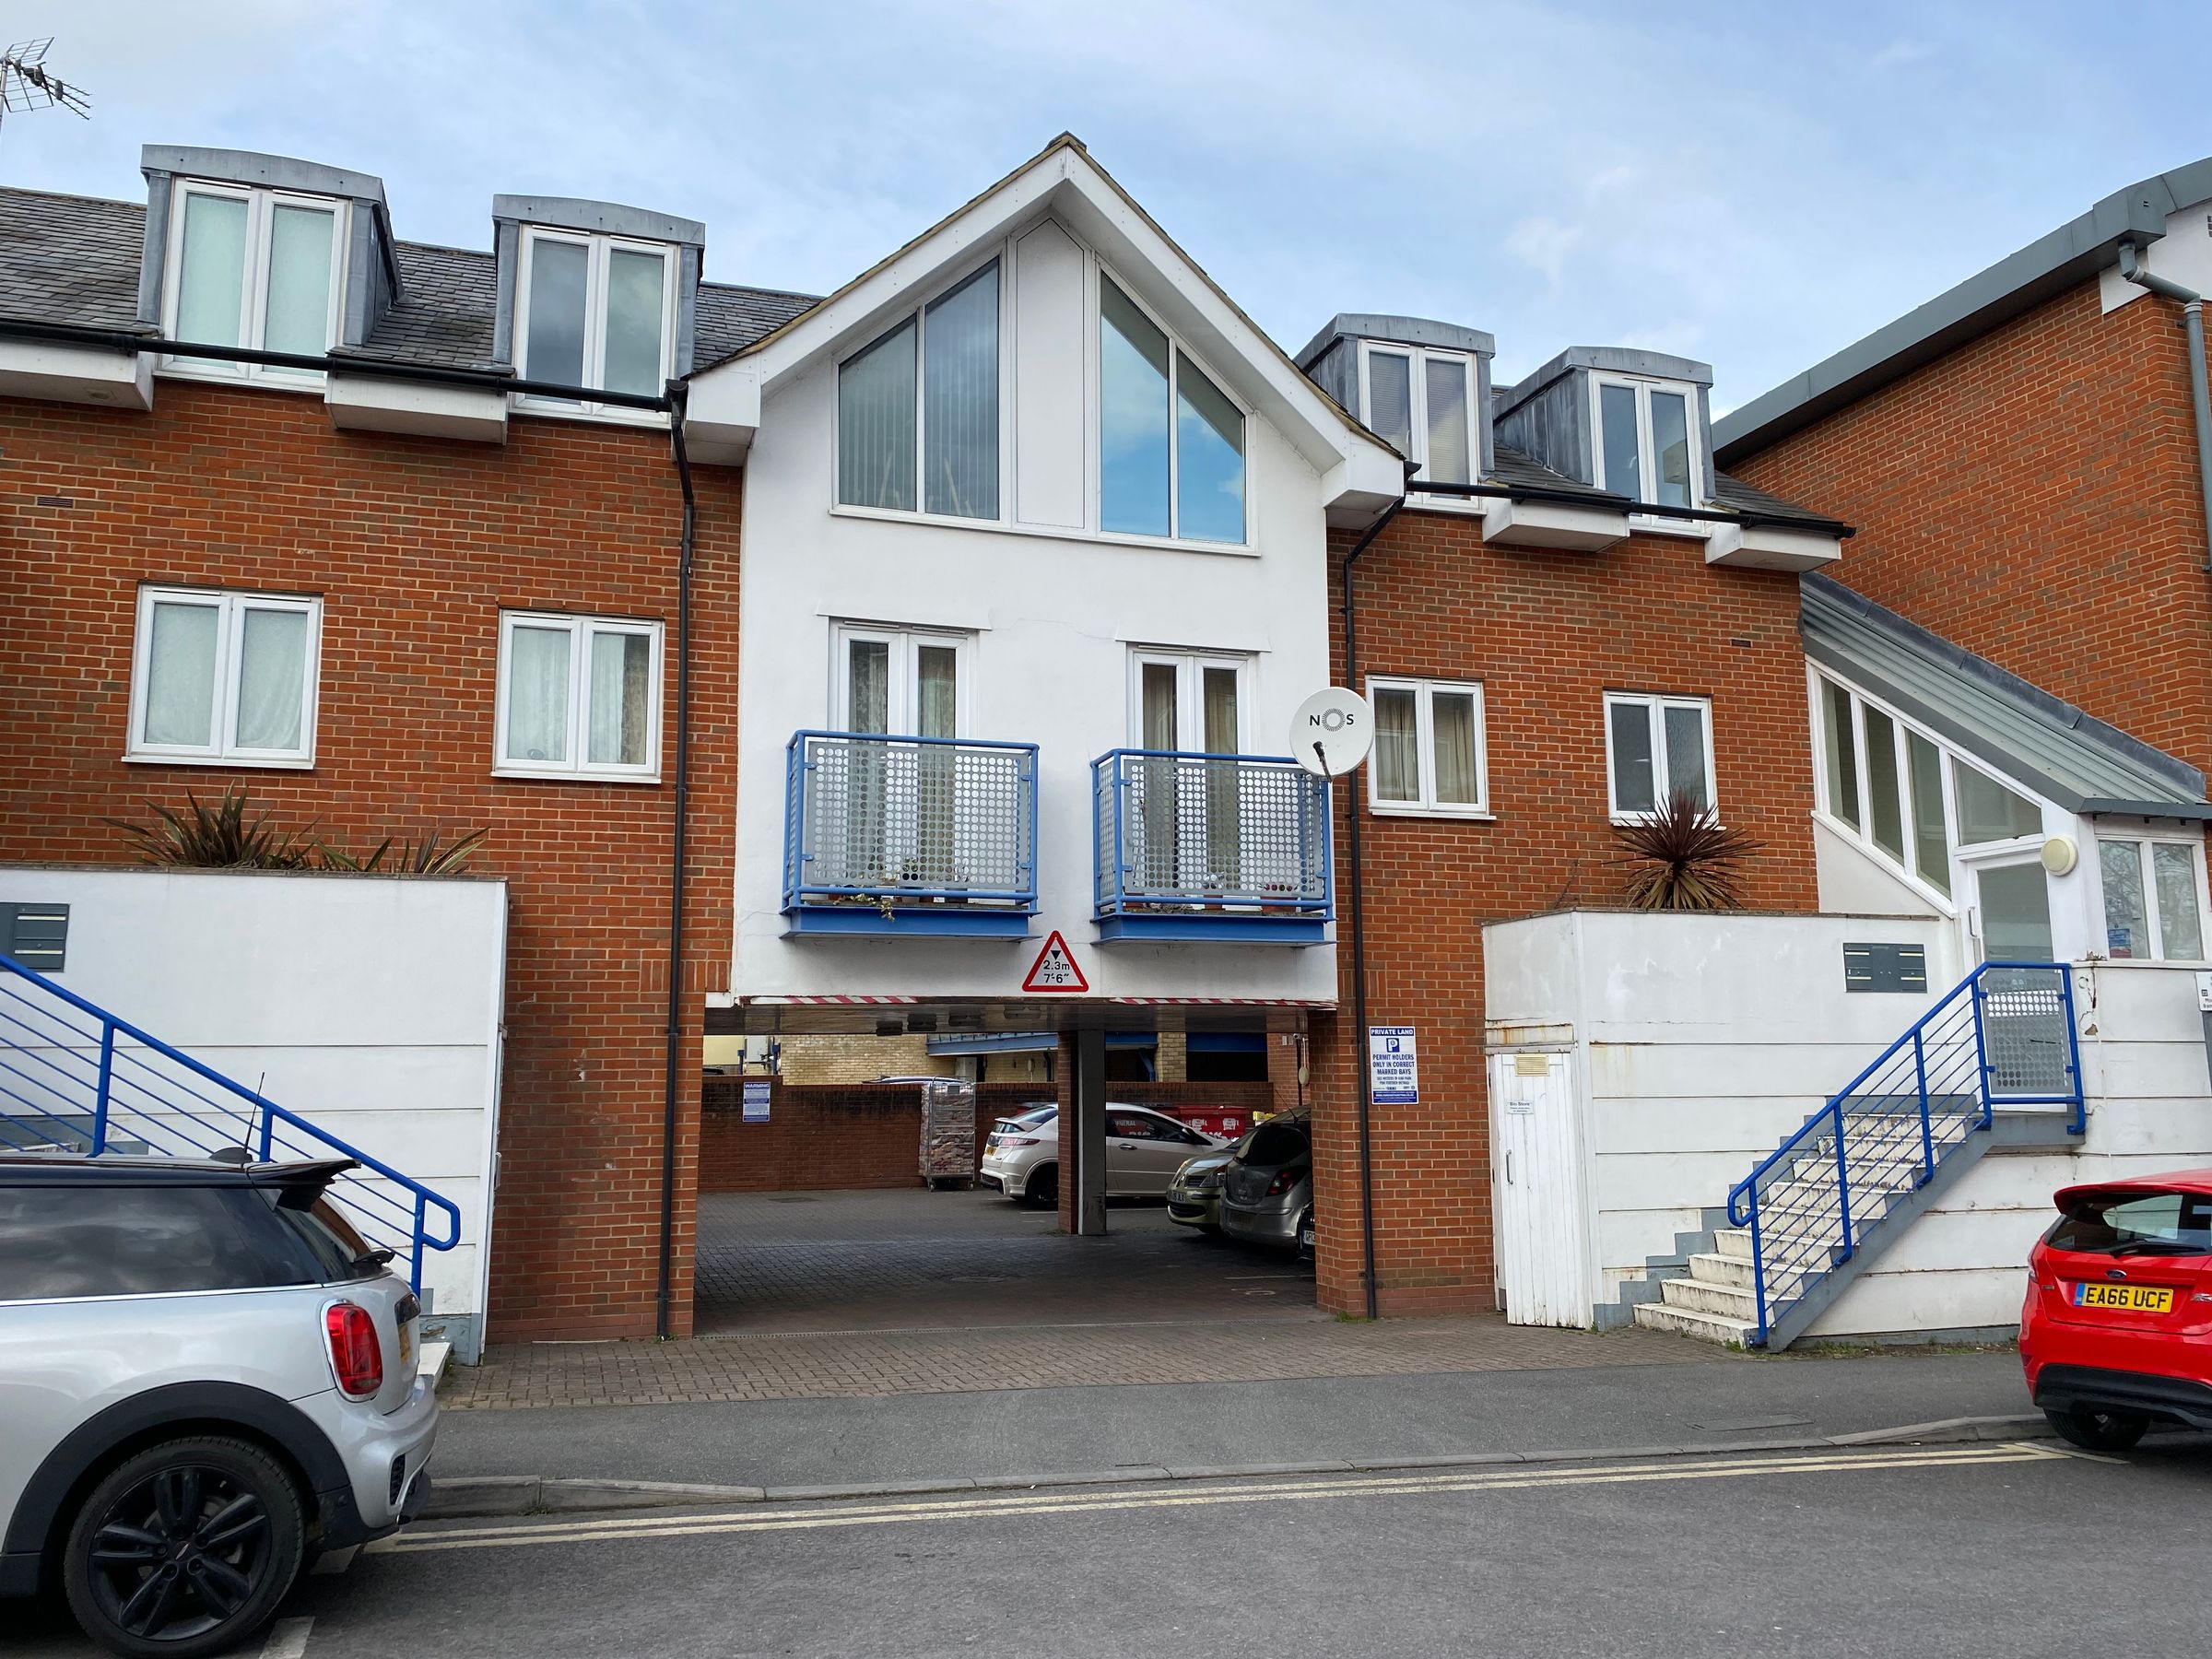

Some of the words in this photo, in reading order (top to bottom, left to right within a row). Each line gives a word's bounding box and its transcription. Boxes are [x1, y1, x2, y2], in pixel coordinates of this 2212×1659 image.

[1043, 959, 1070, 971] 2.3m
[2085, 1287, 2130, 1306] EA66
[2133, 1289, 2170, 1309] UCF
